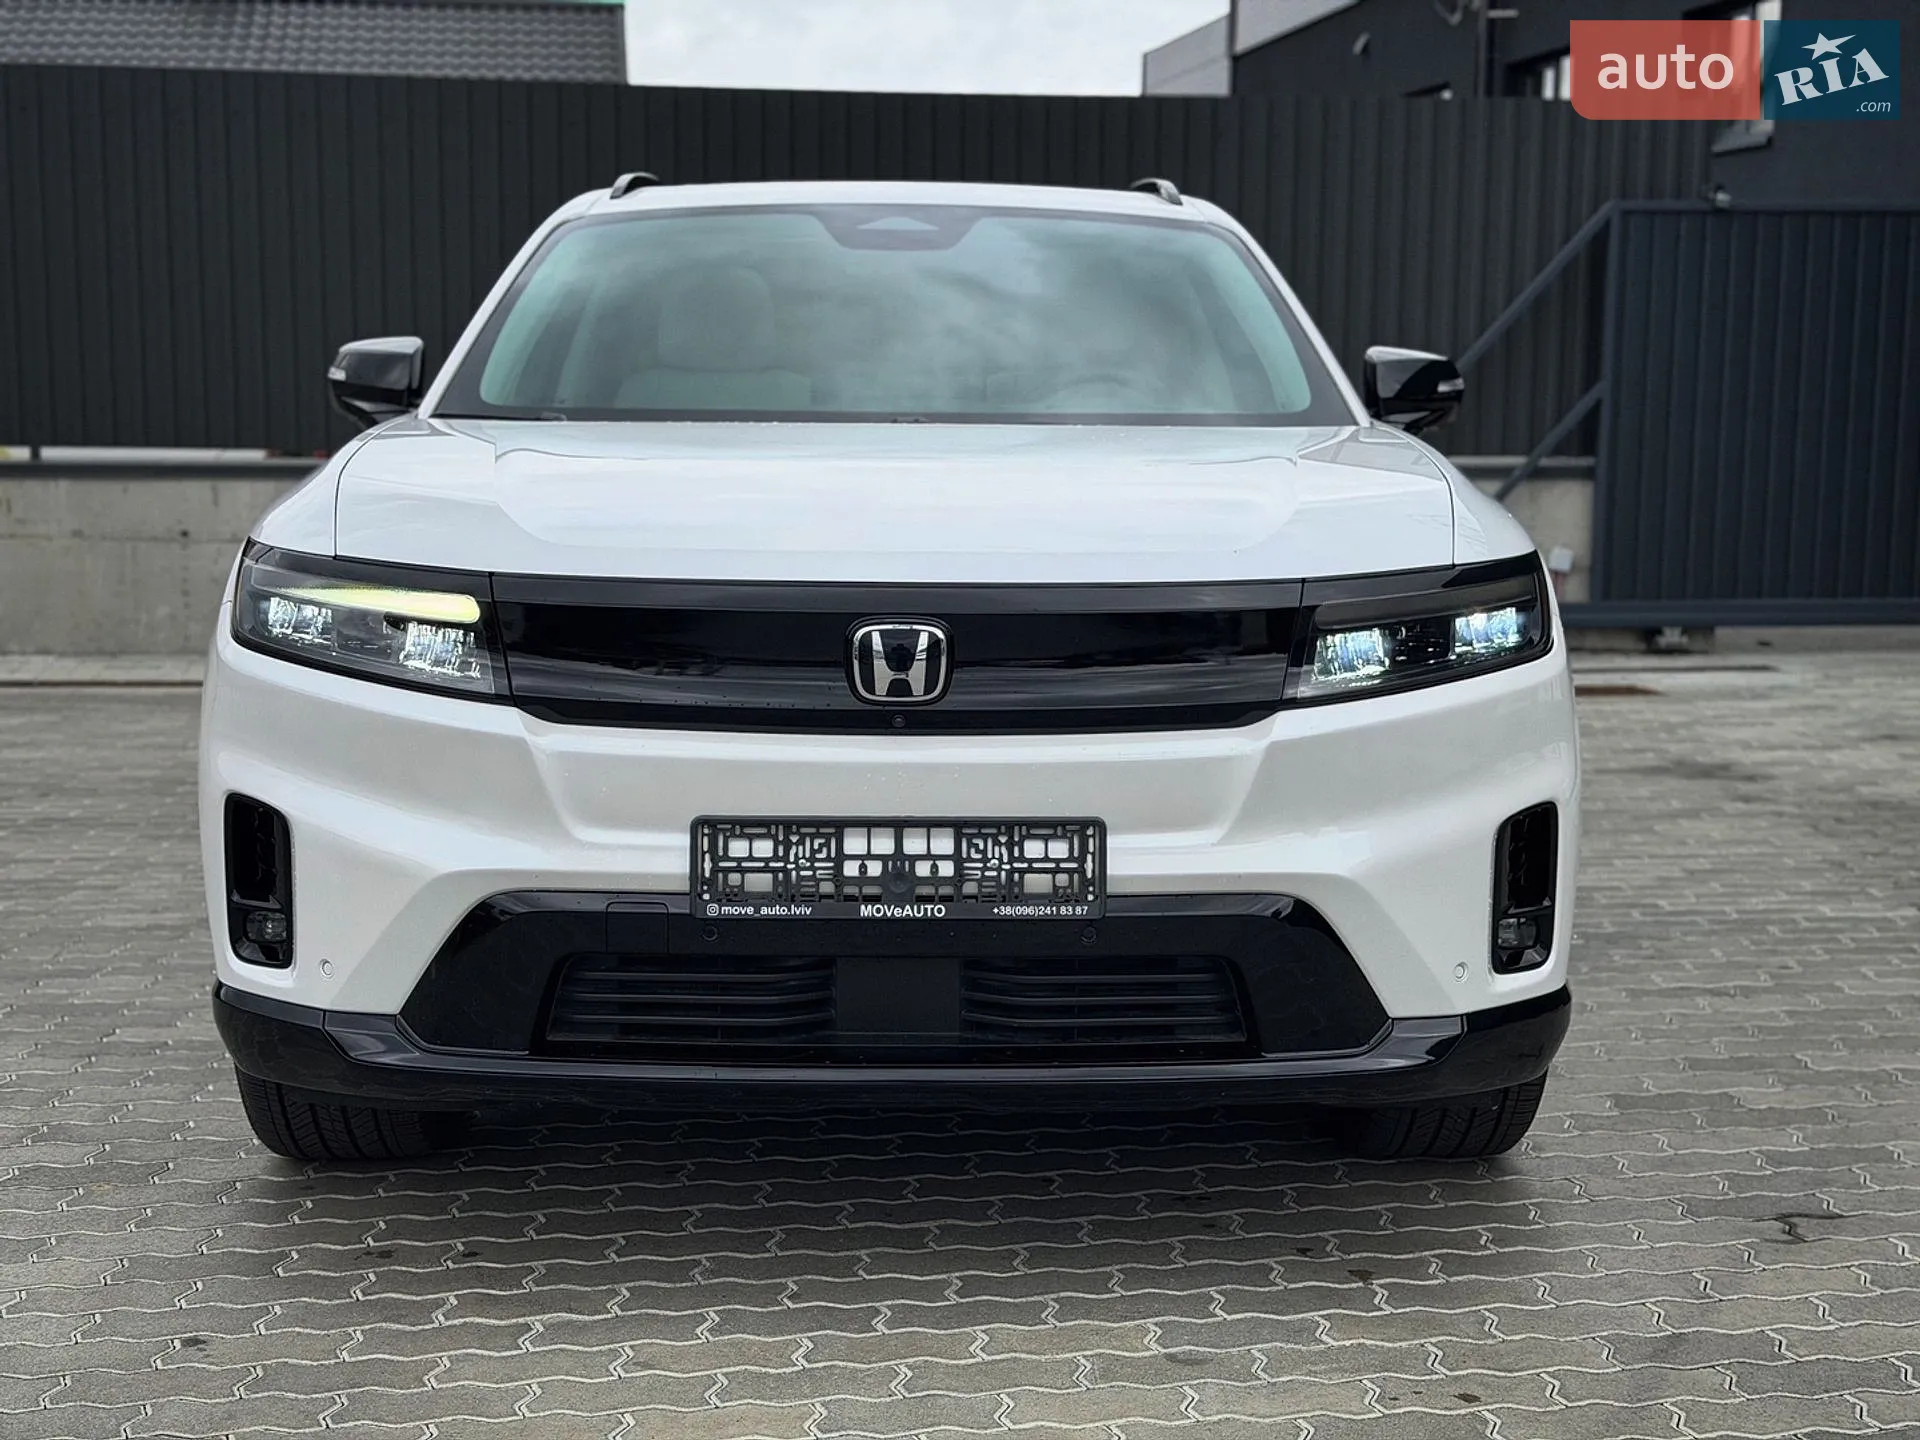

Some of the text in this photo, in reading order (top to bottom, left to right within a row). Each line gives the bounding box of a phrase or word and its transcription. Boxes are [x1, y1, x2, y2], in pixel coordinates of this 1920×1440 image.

[721, 904, 812, 917] move_auto.lviv
[859, 904, 946, 918] MOVeAUTO
[992, 906, 1088, 917] +38(096)241 83 87
